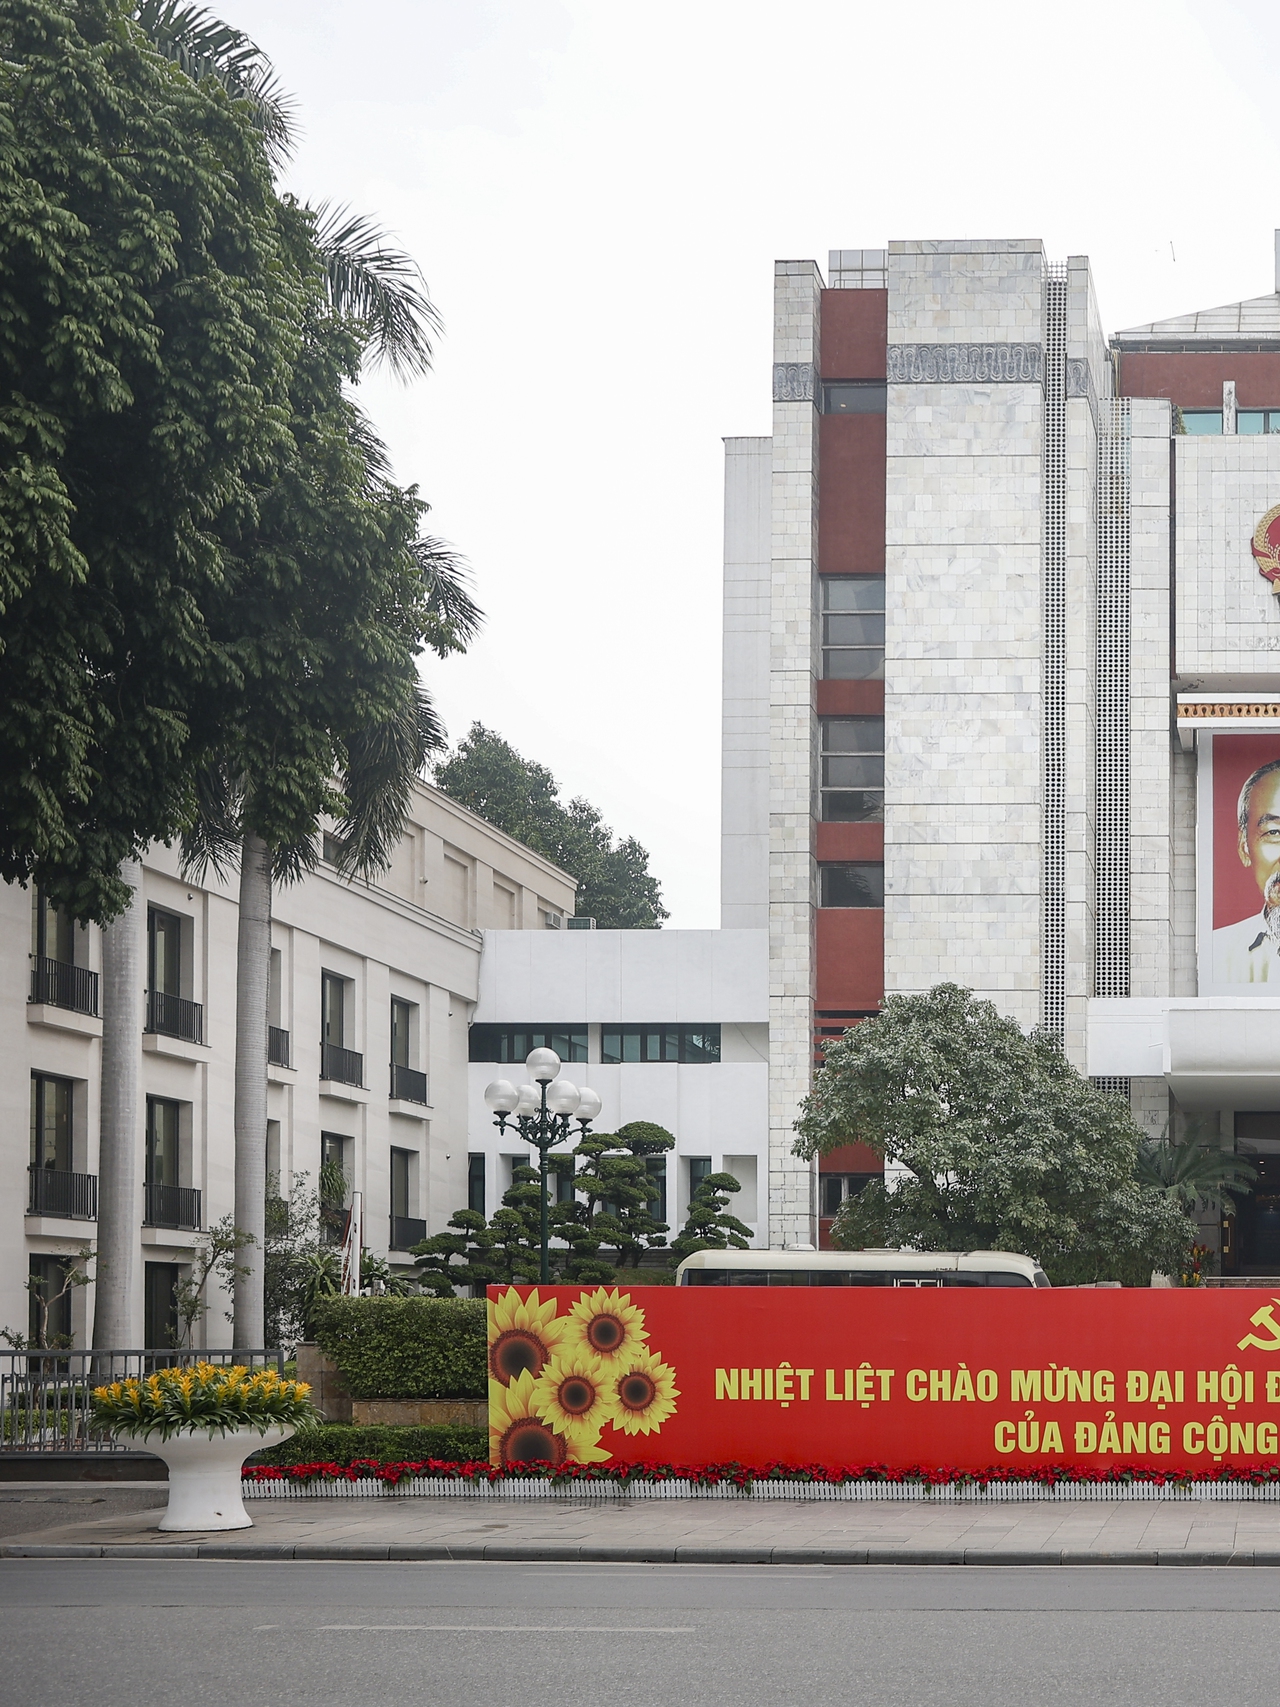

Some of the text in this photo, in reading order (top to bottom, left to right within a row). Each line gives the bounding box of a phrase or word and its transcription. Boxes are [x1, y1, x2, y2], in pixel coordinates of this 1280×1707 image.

[715, 1361, 815, 1408] NHIỆT
[825, 1362, 895, 1408] LIỆT
[906, 1362, 999, 1402] CHÀO
[1010, 1363, 1115, 1403] MỪNG
[1125, 1370, 1185, 1410] ĐẠI
[1196, 1363, 1254, 1411] HỘI
[994, 1410, 1065, 1454] CỦA
[1073, 1410, 1171, 1454] ĐẢNG
[1182, 1415, 1278, 1462] CỘNG
